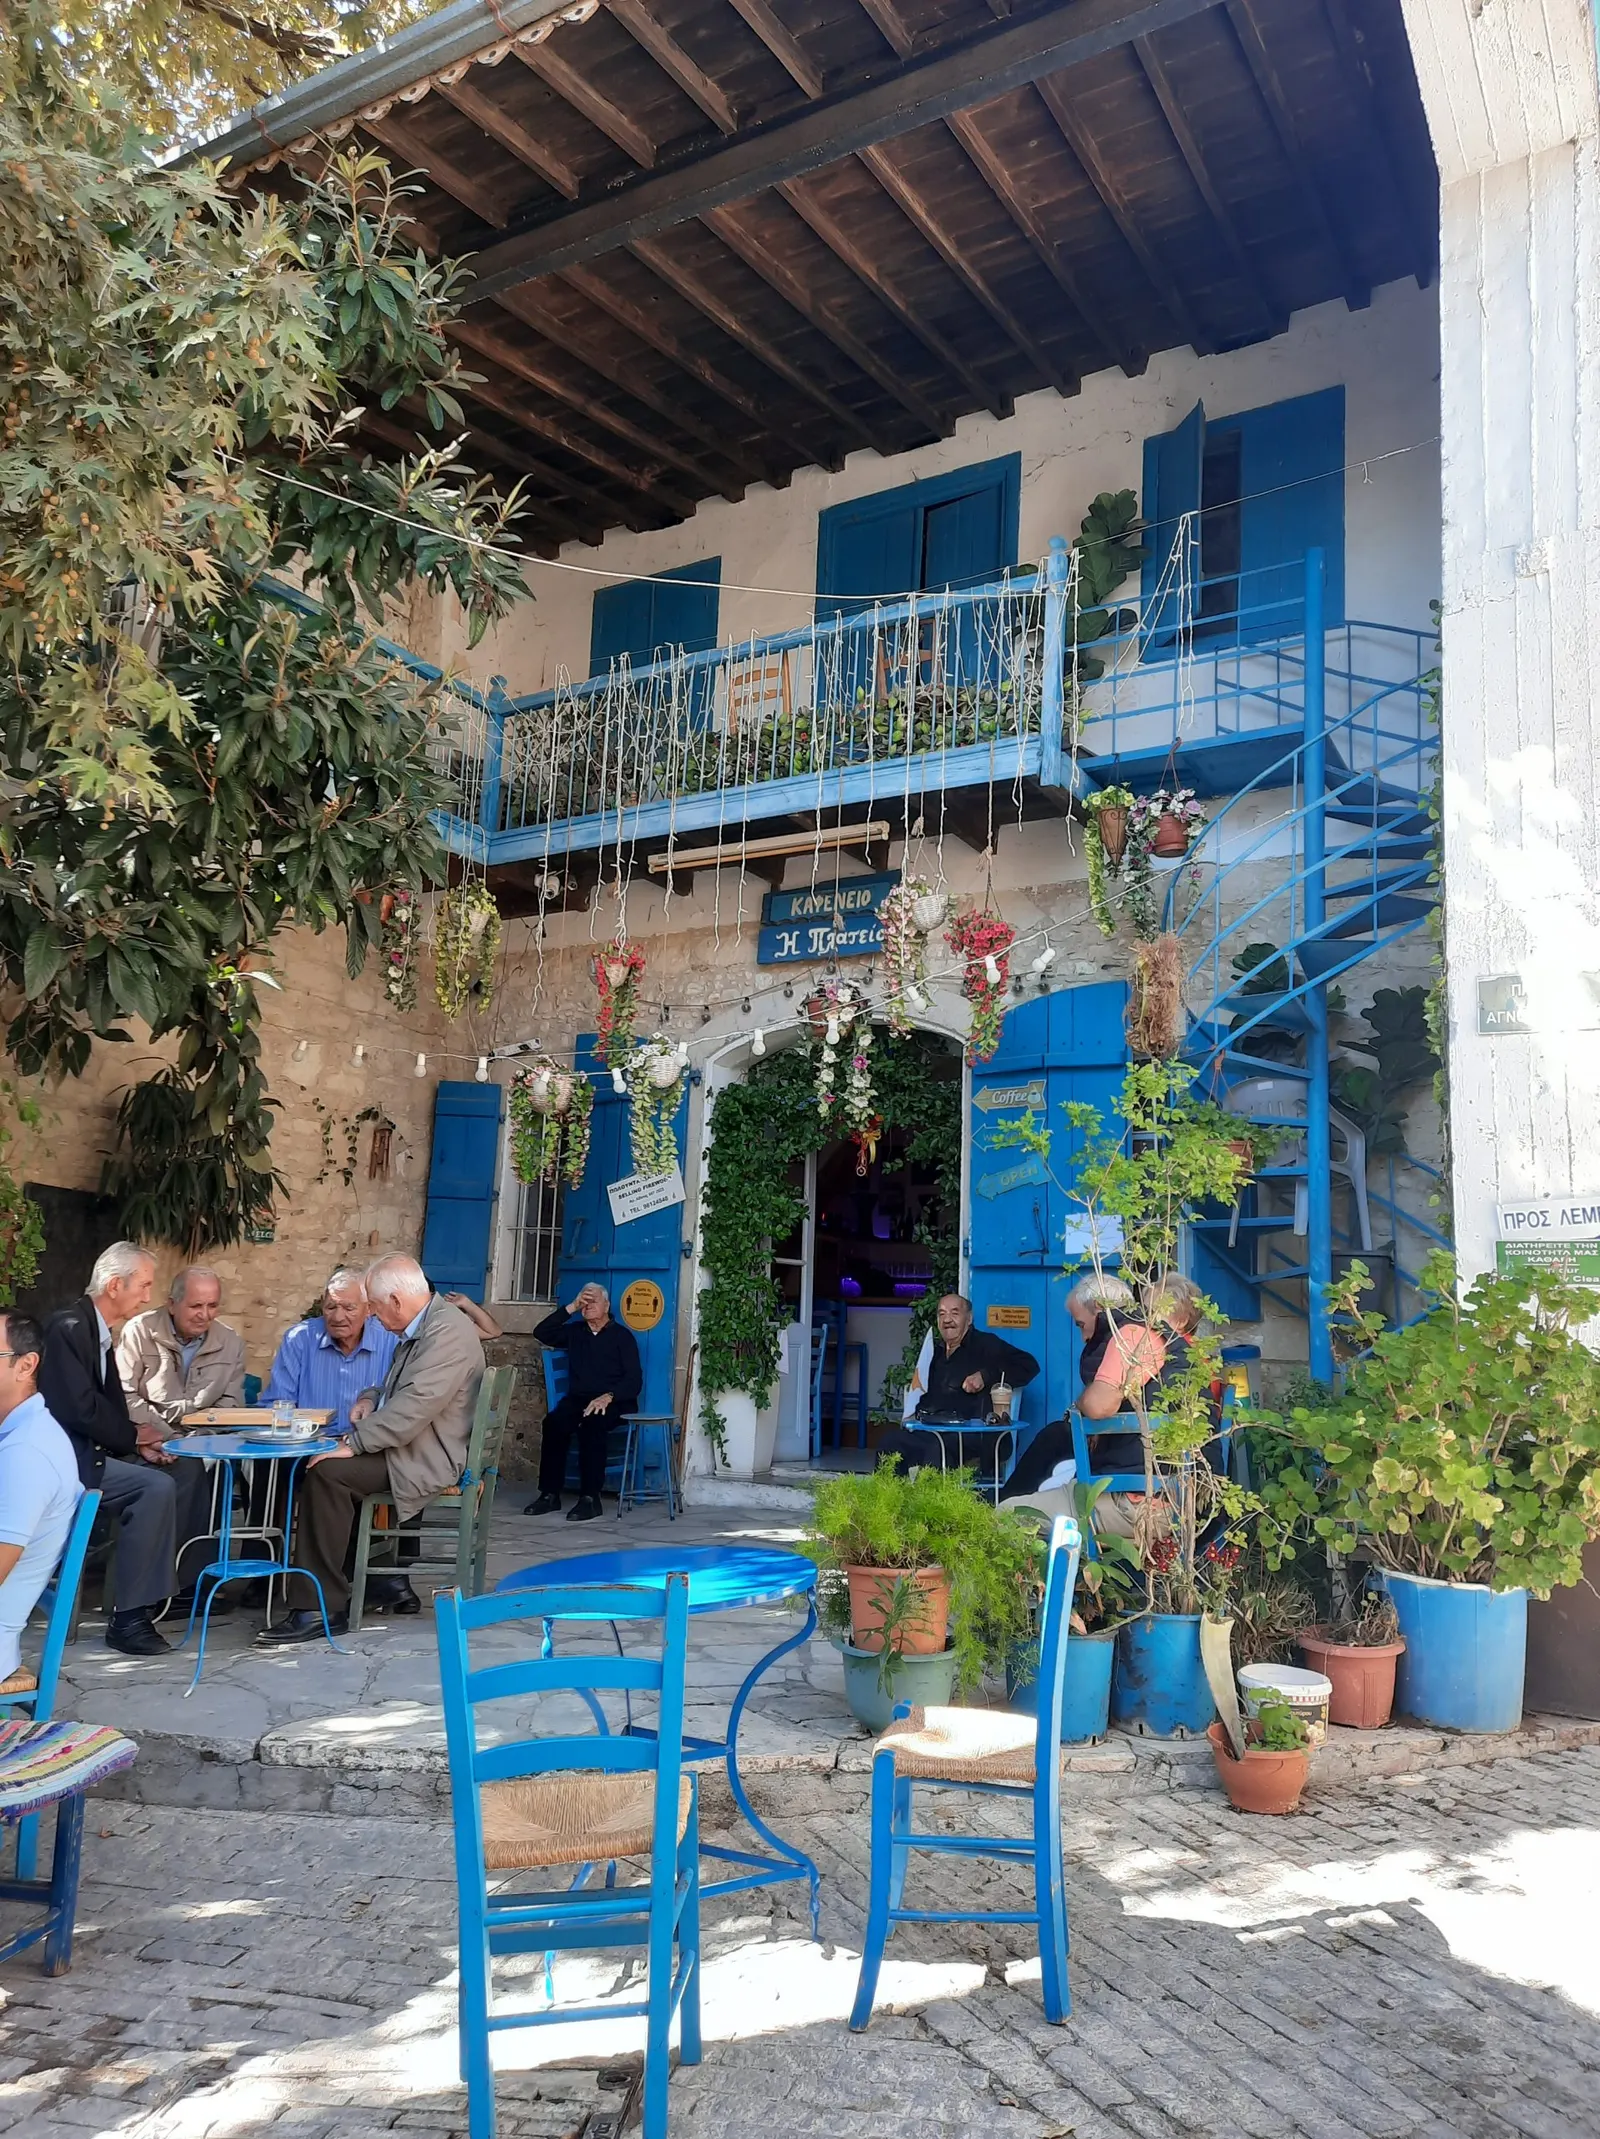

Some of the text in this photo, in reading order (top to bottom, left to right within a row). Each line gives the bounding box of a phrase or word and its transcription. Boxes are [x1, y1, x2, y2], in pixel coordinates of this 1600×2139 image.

[790, 889, 872, 917] ΚΑΦΕΝΕΙΟ
[774, 930, 801, 958] Η
[1486, 1010, 1517, 1024] ΑΓΝ
[992, 1089, 1027, 1105] Coffee
[1001, 1164, 1037, 1186] OPEN
[618, 1186, 642, 1200] SELLING
[1503, 1210, 1551, 1230] ΠΡΟΣ
[1572, 1275, 1600, 1283] Clea
